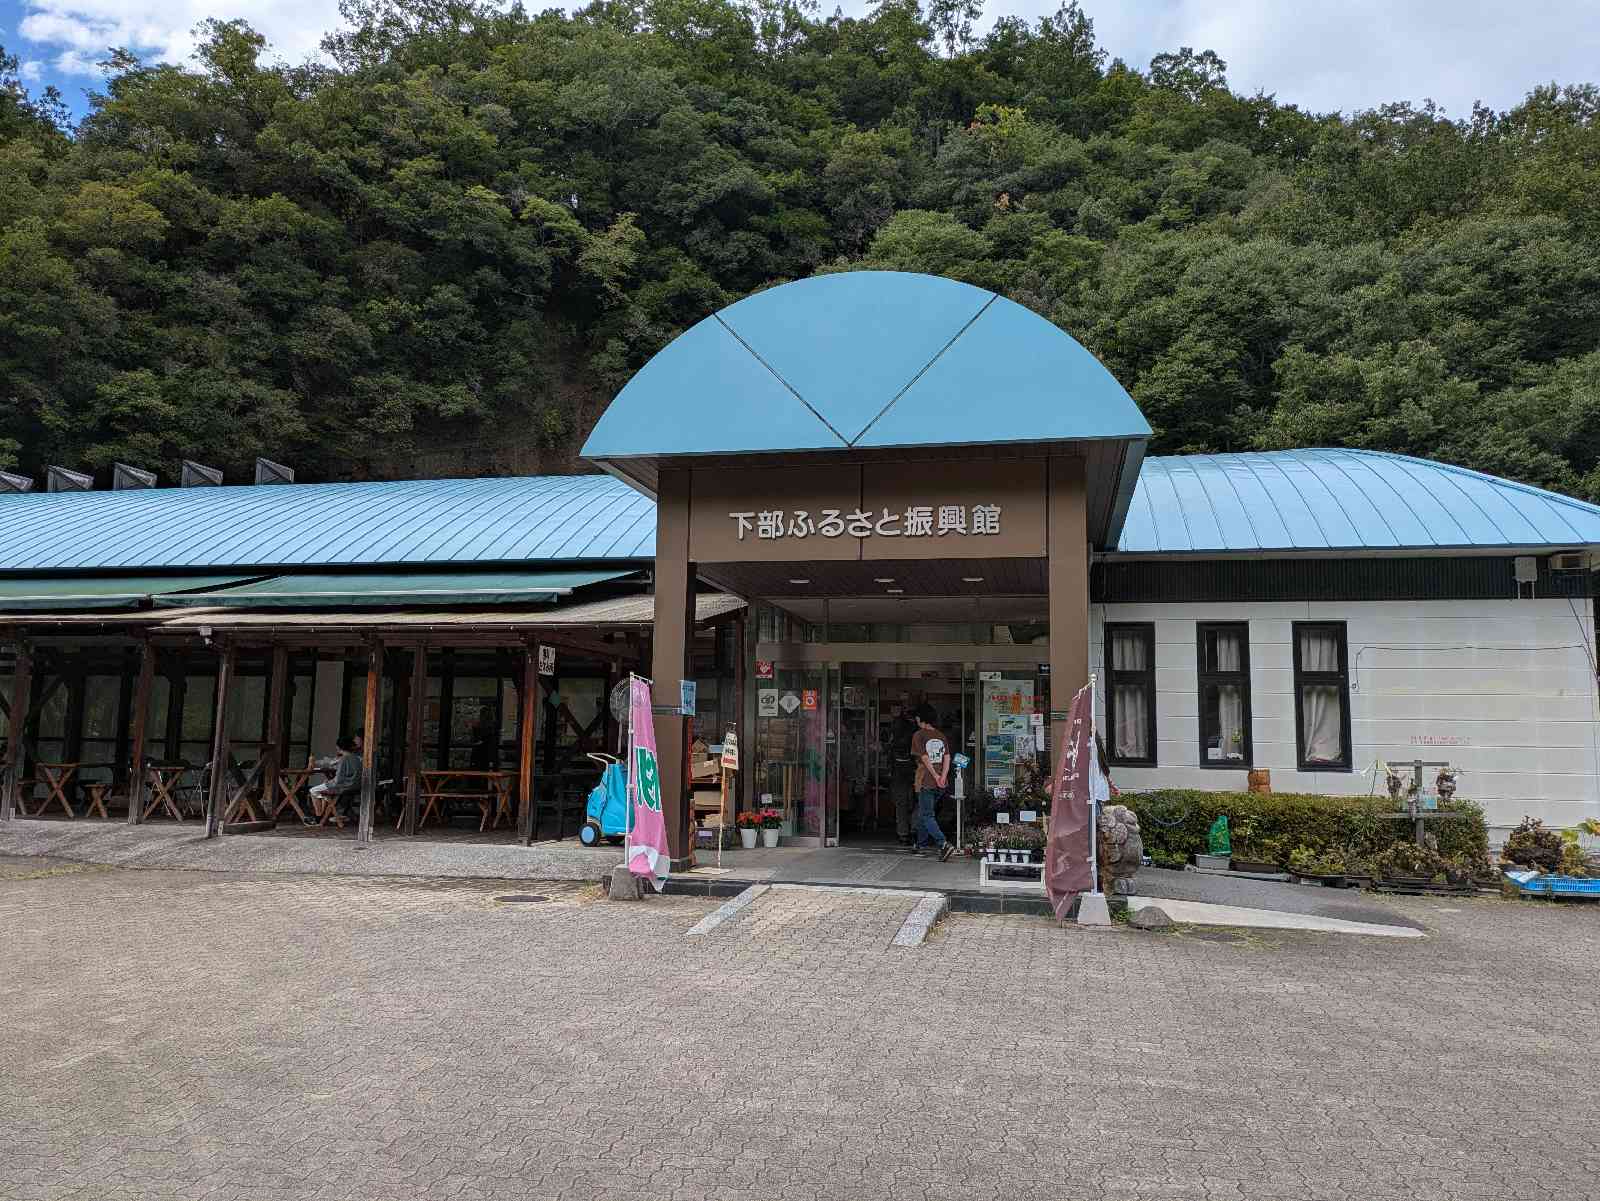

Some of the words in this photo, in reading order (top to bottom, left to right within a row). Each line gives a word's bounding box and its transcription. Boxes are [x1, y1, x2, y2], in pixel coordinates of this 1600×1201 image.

[729, 504, 1002, 539] 下部ふるさと振興館
